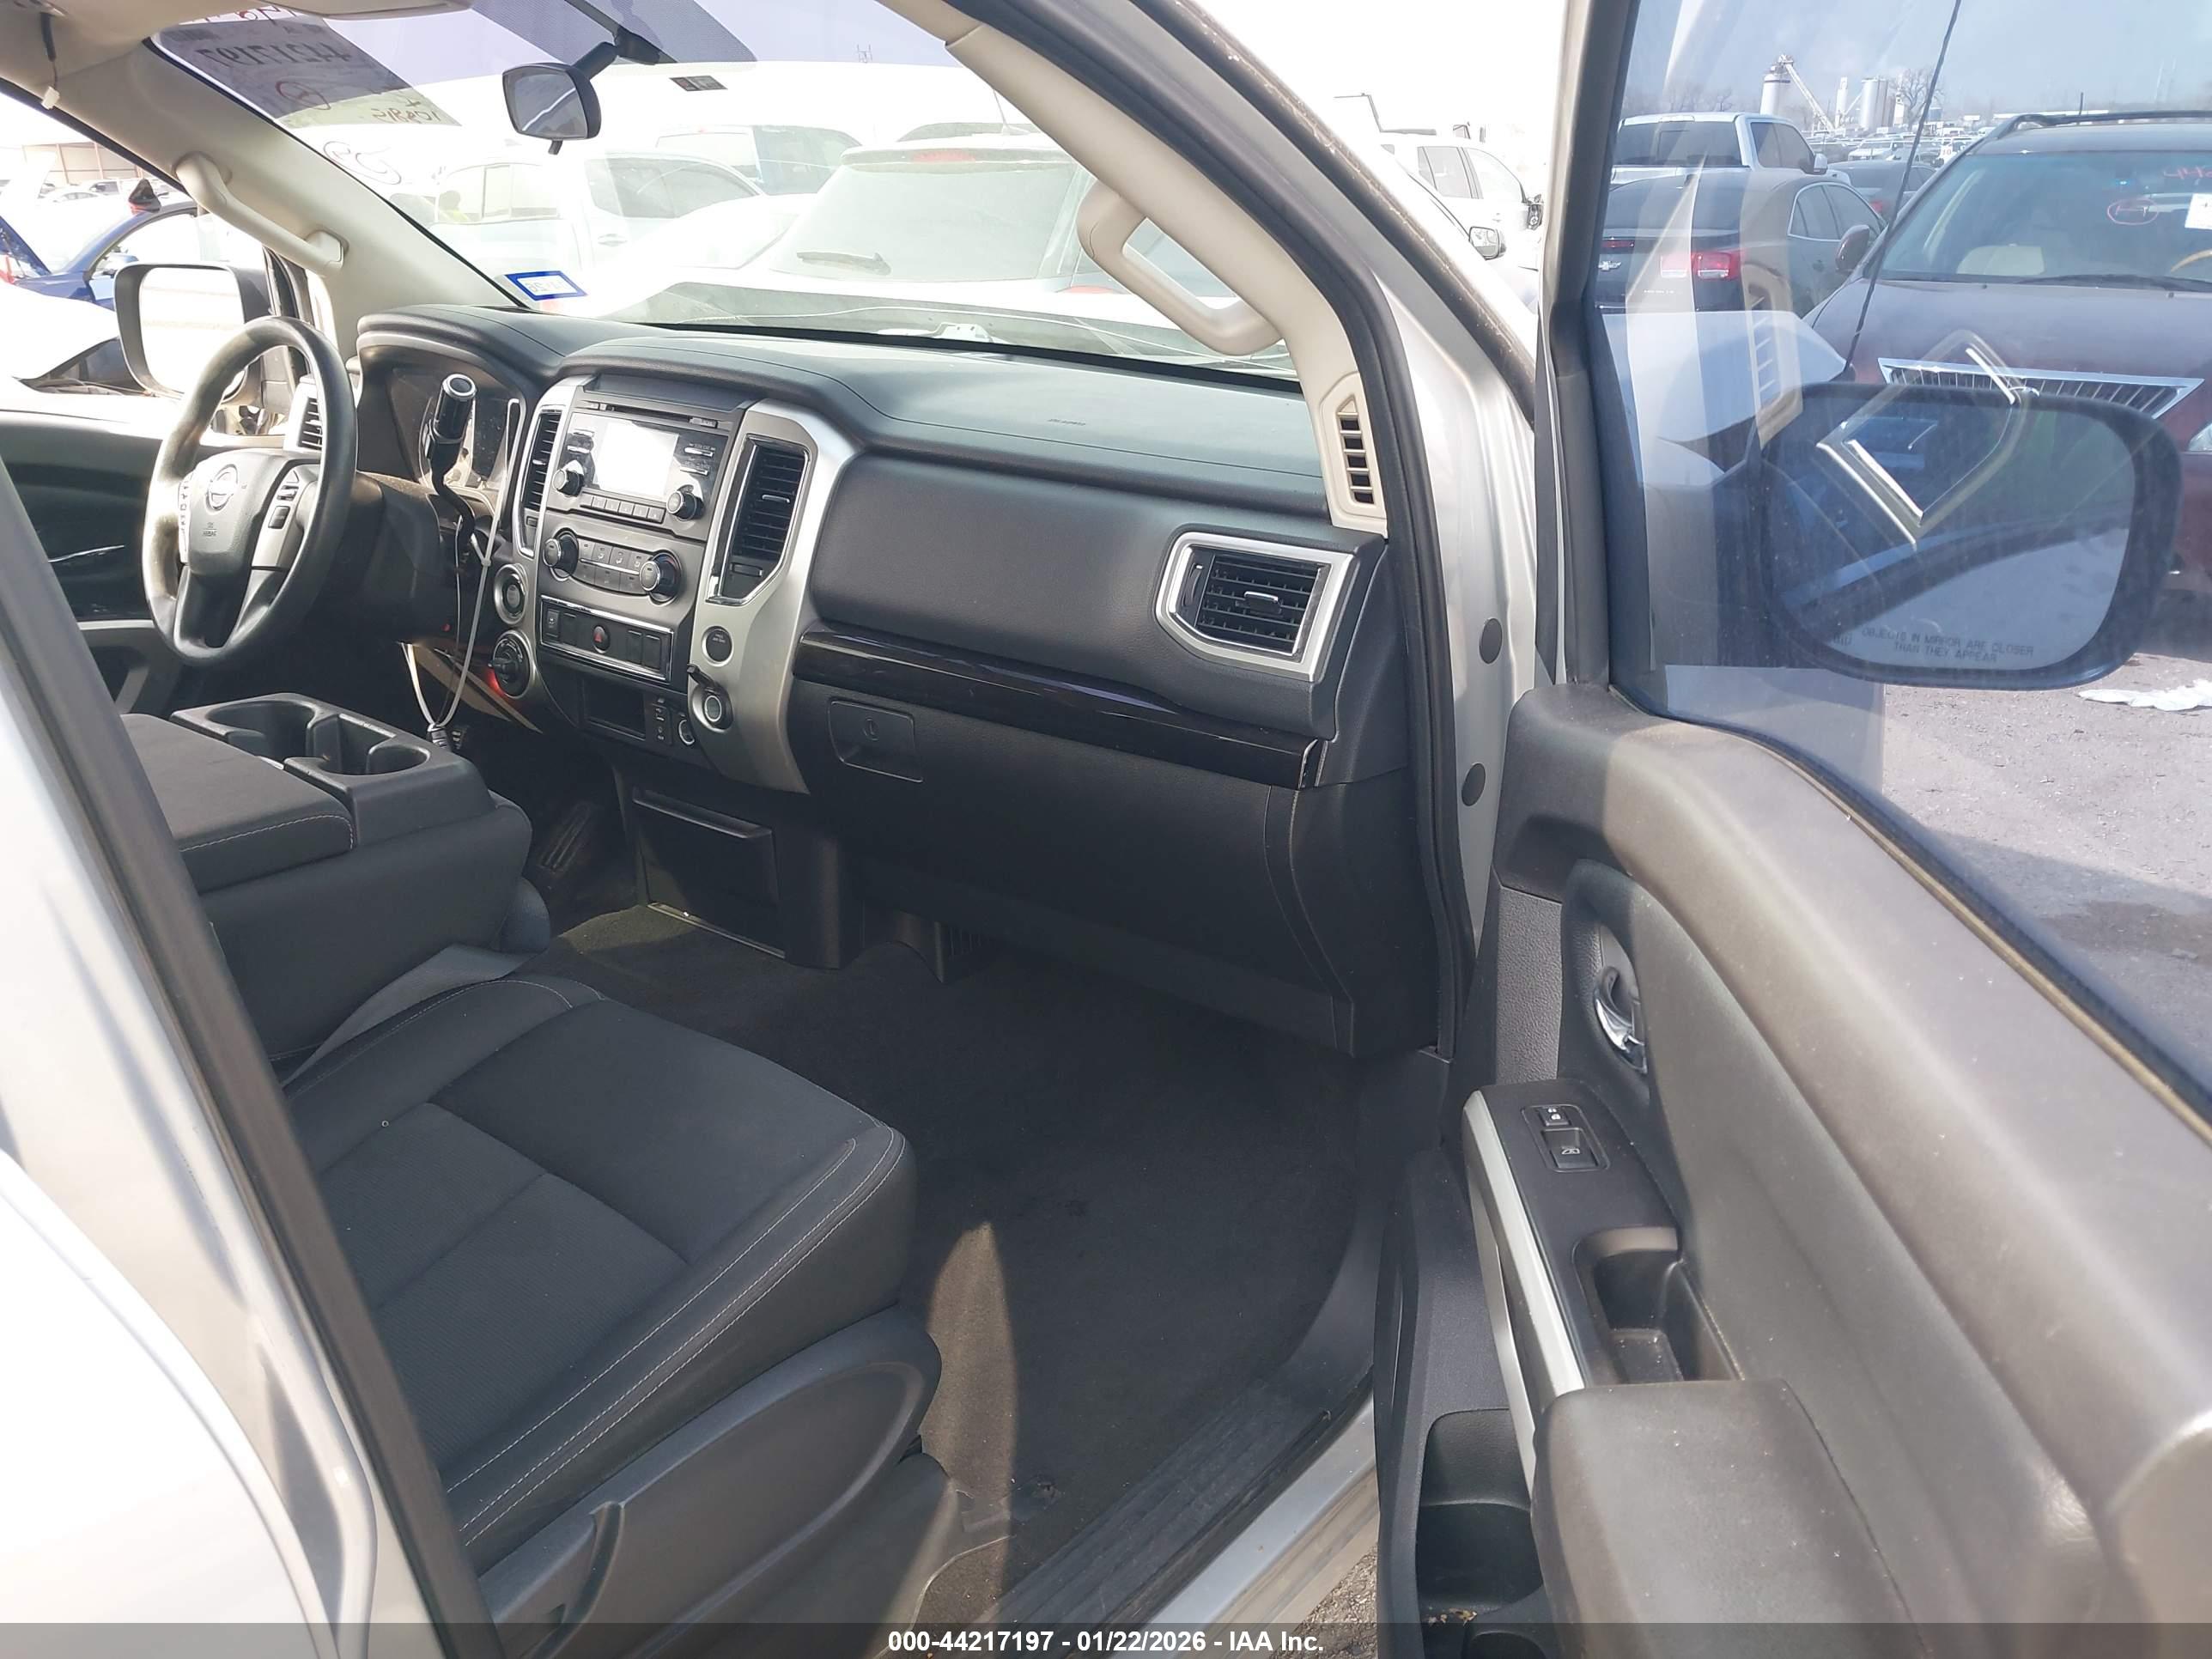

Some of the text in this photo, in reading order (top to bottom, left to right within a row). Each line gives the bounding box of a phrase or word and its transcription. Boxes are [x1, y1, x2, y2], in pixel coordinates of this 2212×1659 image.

[1861, 627, 2034, 658] OBJECTS IN MIRROR ARE CLOSER
[1894, 641, 1997, 663] THAN THEY APPEAR
